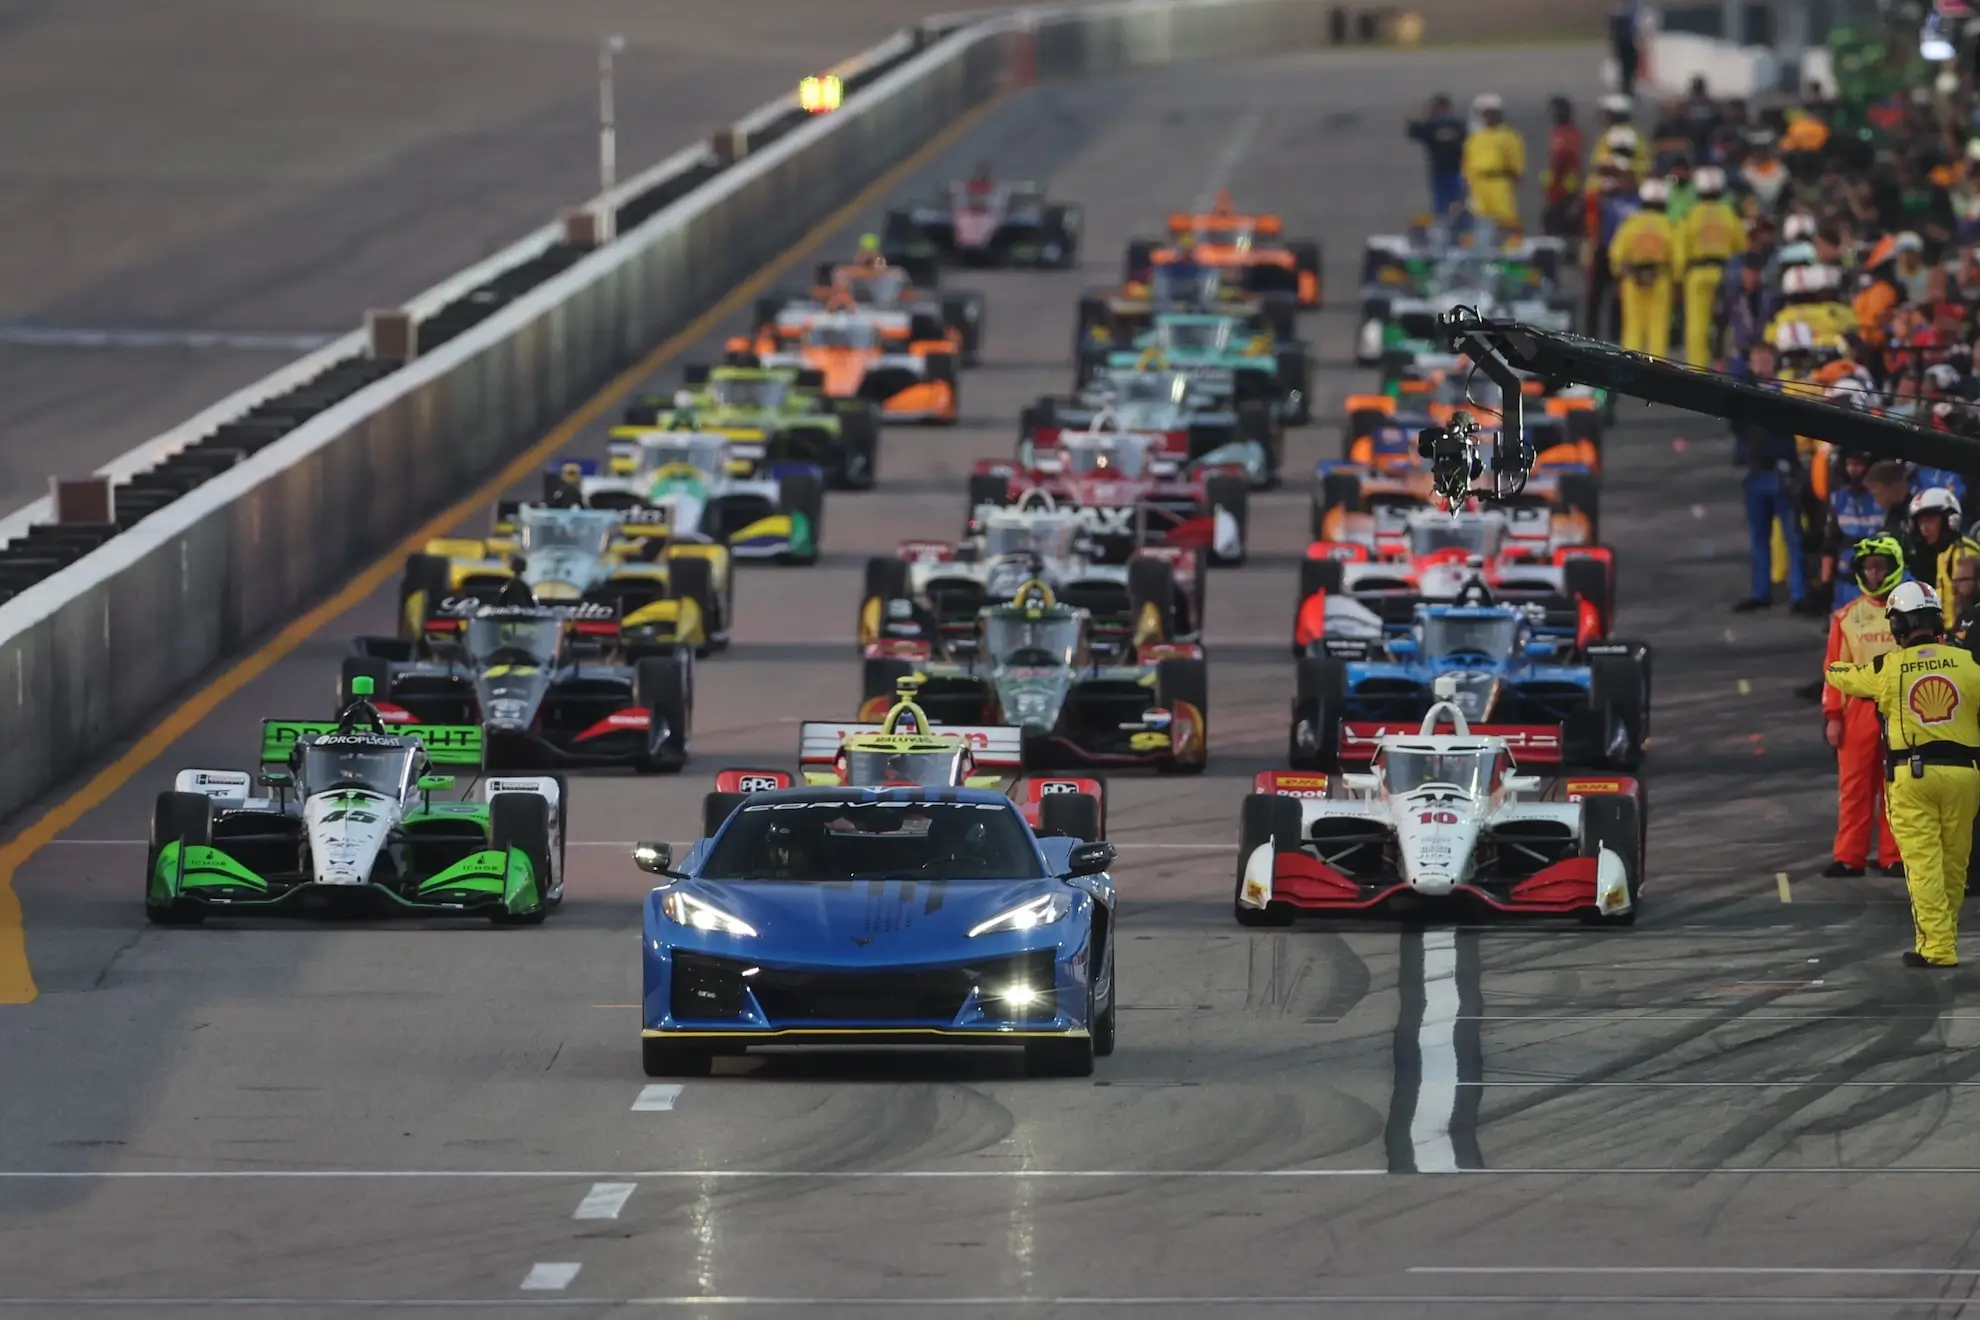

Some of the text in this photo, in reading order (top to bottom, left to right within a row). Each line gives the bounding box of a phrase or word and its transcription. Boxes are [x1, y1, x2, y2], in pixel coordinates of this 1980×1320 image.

[1900, 658, 1958, 674] OFFICIAL
[328, 734, 401, 747] DROPLIGHT
[742, 778, 776, 792] PPG
[744, 801, 1006, 812] CORVETTE
[320, 810, 380, 824] 45
[1417, 811, 1458, 824] 10
